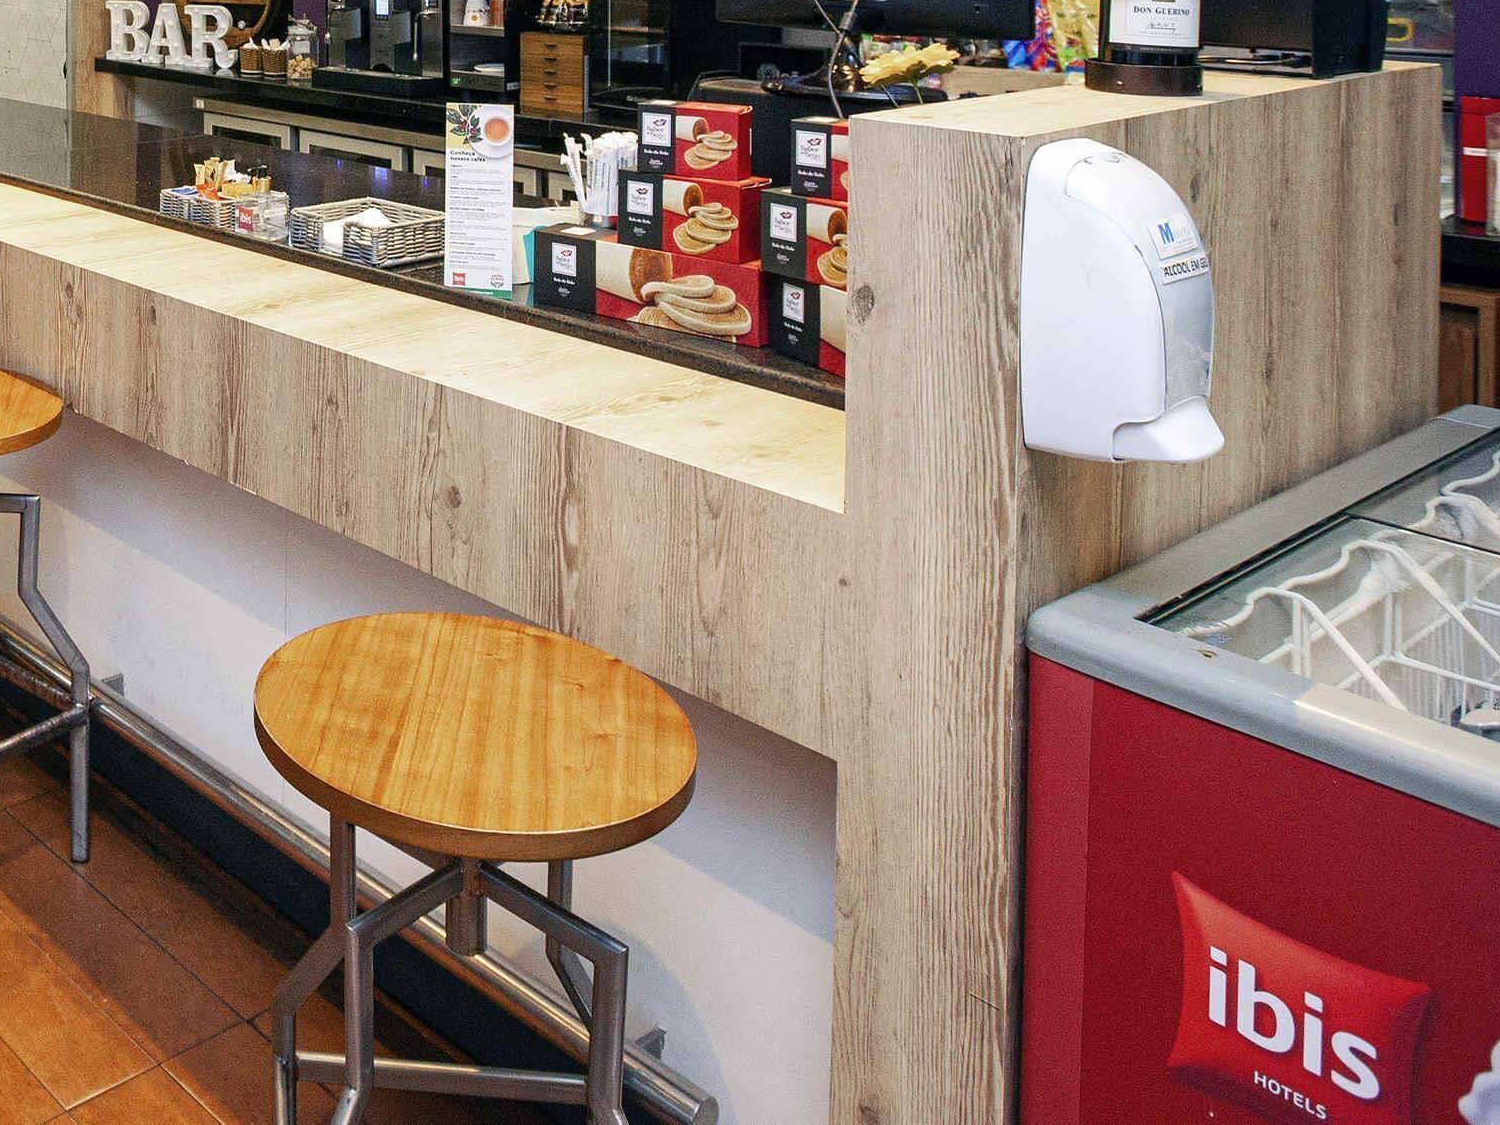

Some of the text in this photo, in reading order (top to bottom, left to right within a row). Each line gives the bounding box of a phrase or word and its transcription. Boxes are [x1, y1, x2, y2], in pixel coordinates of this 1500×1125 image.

[105, 0, 238, 69] BAR
[1133, 5, 1191, 16] DON GUERINO
[1209, 945, 1380, 1100] ibis
[1253, 1070, 1327, 1120] HOTELS
